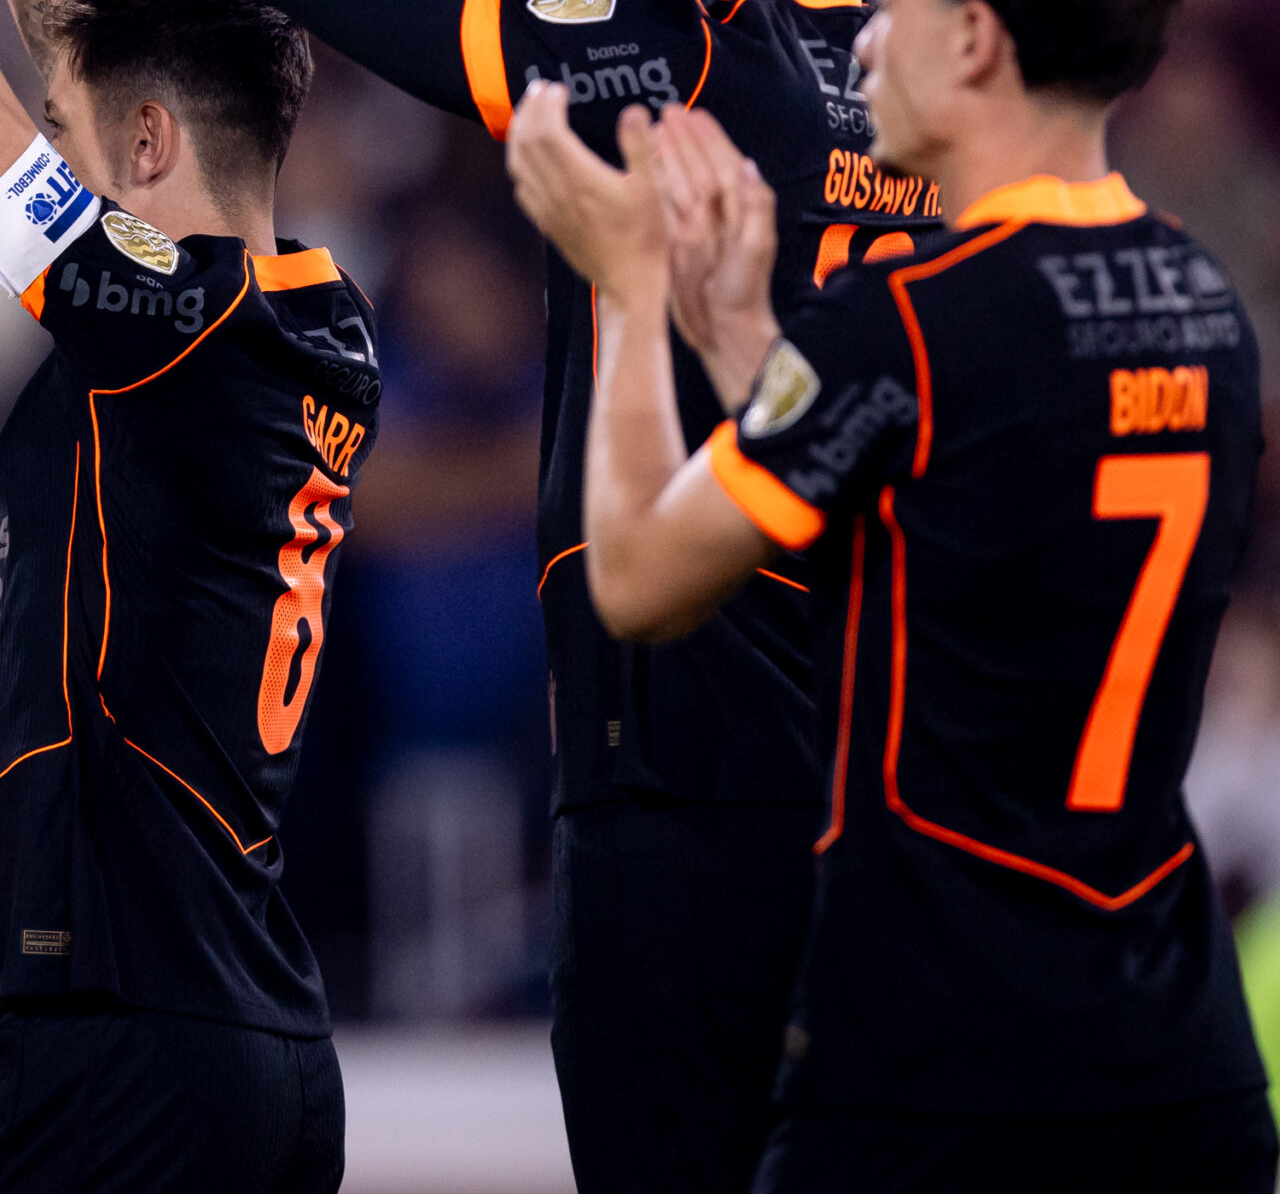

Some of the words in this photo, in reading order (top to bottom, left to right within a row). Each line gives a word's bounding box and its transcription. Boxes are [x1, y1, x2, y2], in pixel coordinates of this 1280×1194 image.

[560, 55, 679, 109] bmg
[586, 41, 640, 62] banco
[96, 270, 206, 334] bmg
[302, 394, 366, 478] GARR
[258, 466, 350, 756] 8
[1065, 451, 1211, 813] 7
